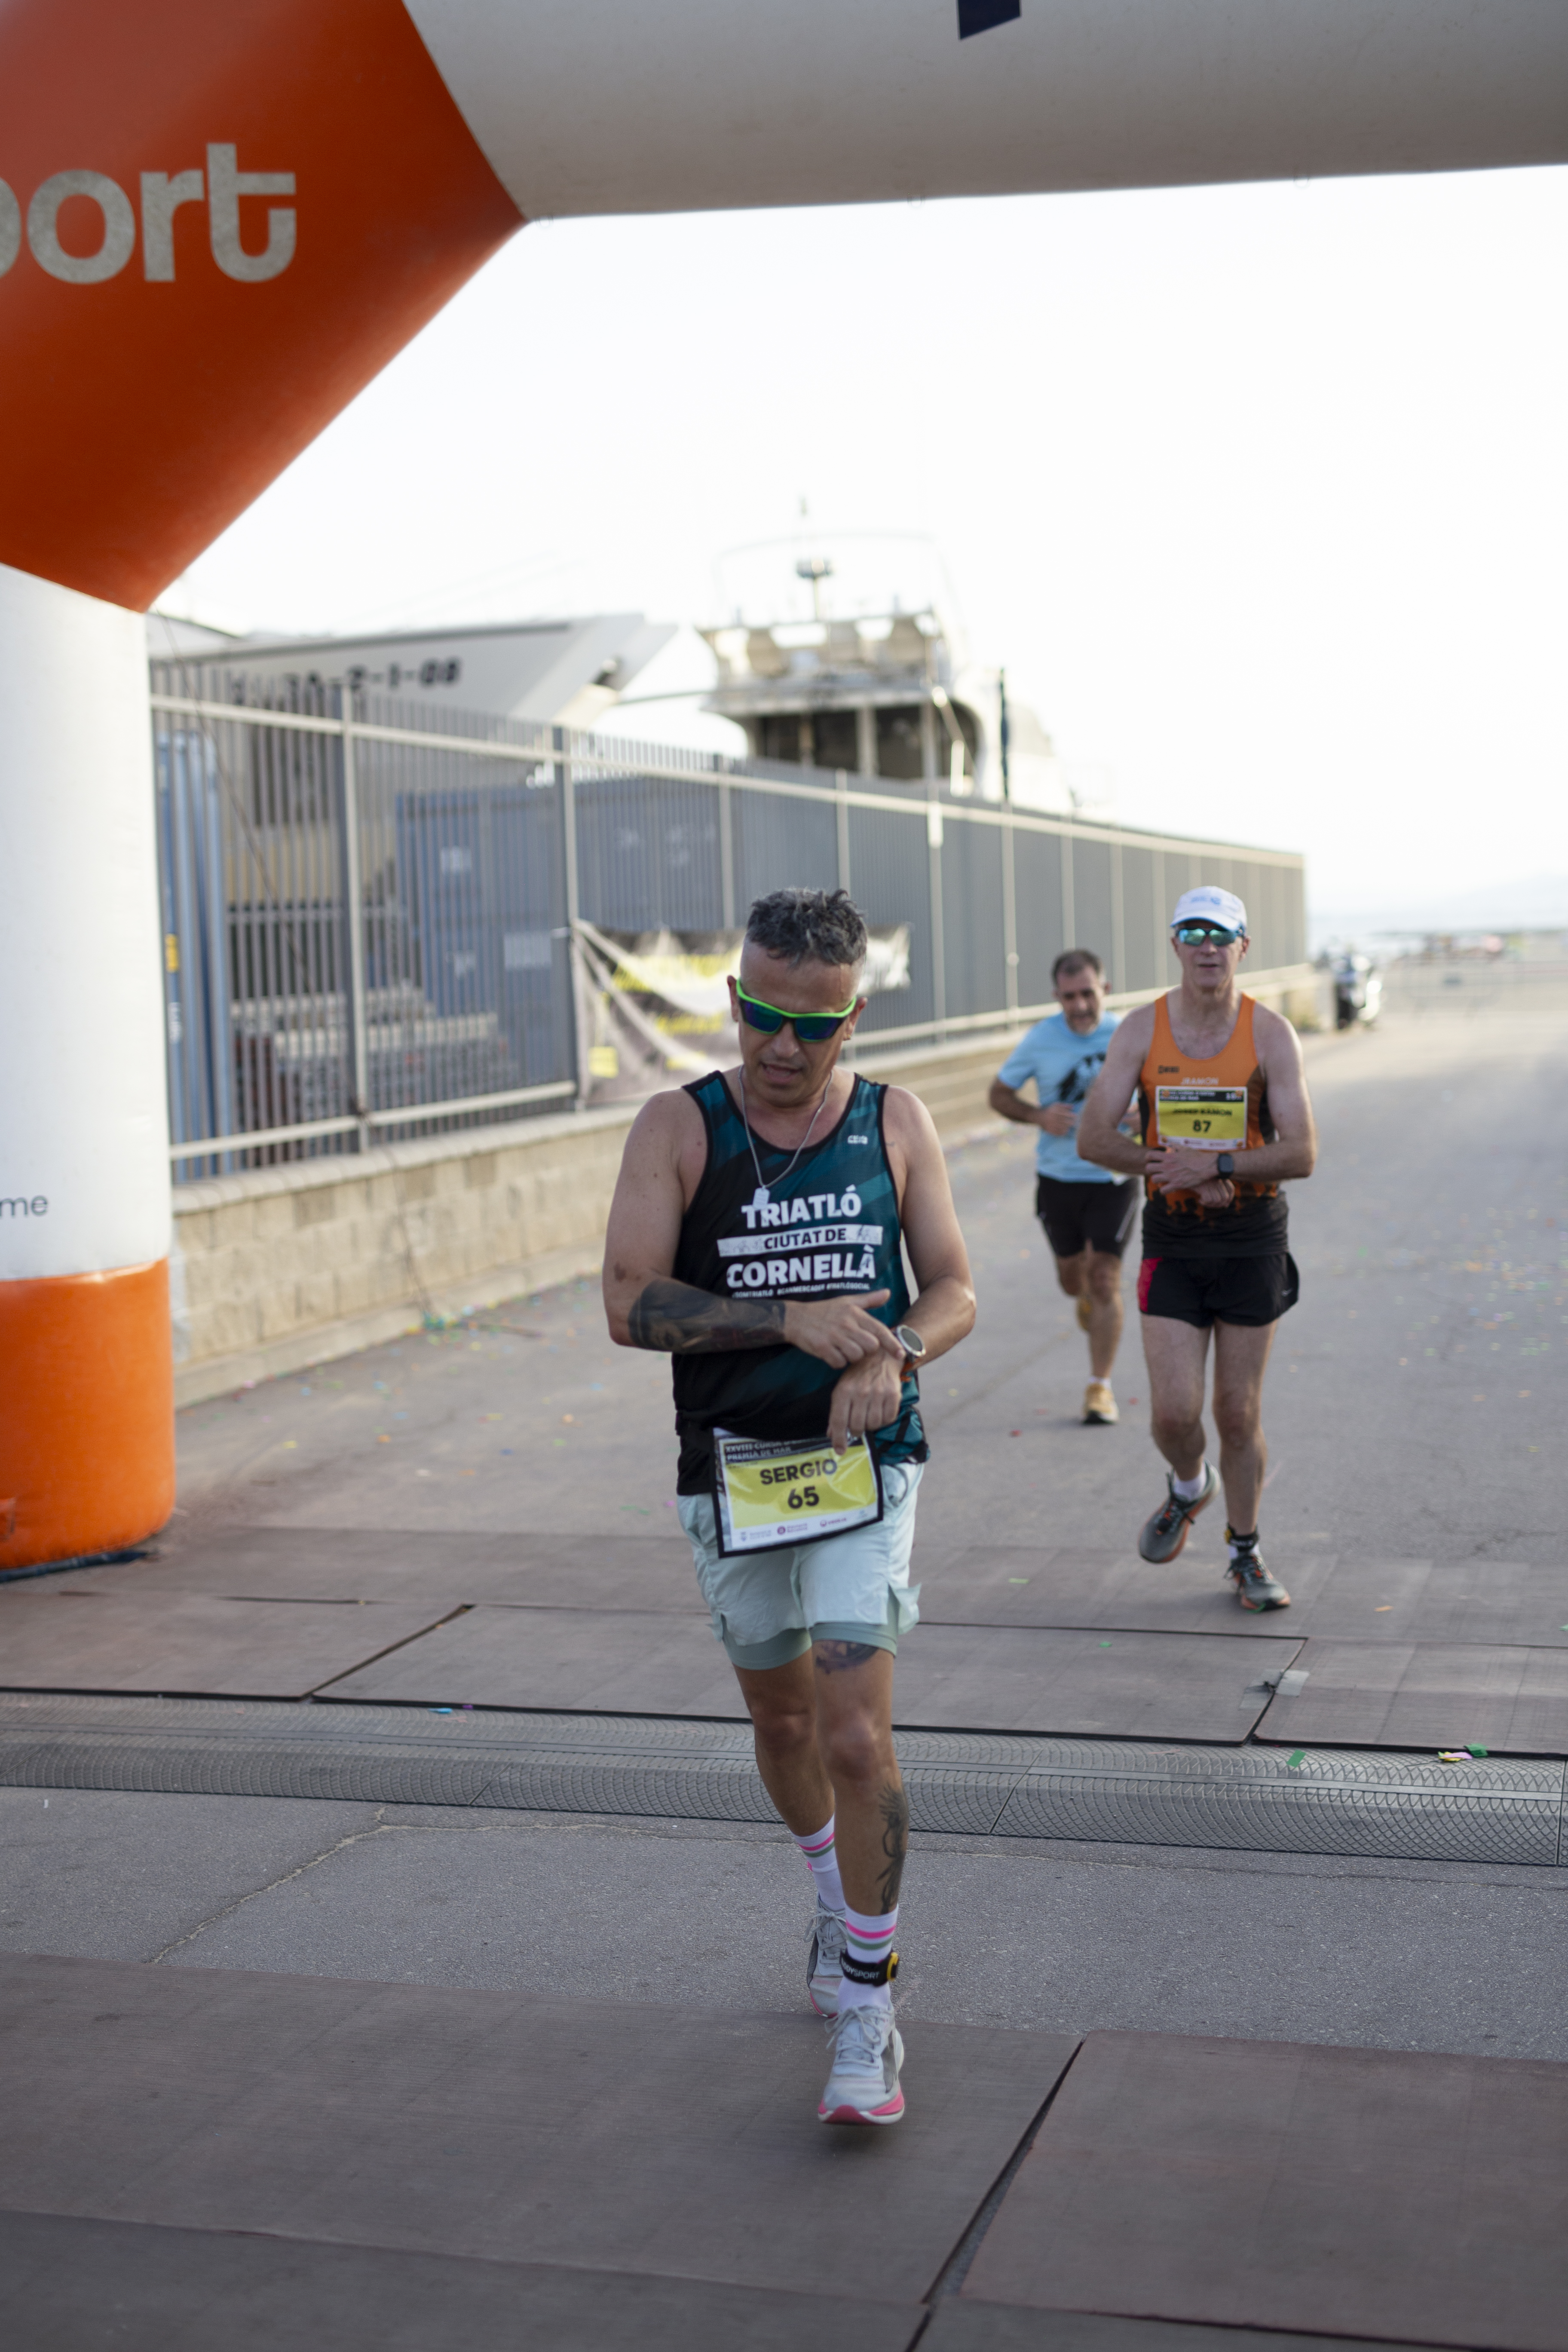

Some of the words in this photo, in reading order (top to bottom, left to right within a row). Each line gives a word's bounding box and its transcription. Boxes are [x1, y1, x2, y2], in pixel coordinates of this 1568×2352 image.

[0, 142, 297, 285] ort
[1193, 1119, 1211, 1133] 87
[741, 1184, 861, 1228] TRIATLÓ
[764, 1230, 822, 1250] CIUTAT
[824, 1228, 847, 1241] DE
[726, 1244, 876, 1288] CORNELLÀ
[760, 1459, 837, 1485] SERGIO
[787, 1486, 820, 1509] 65
